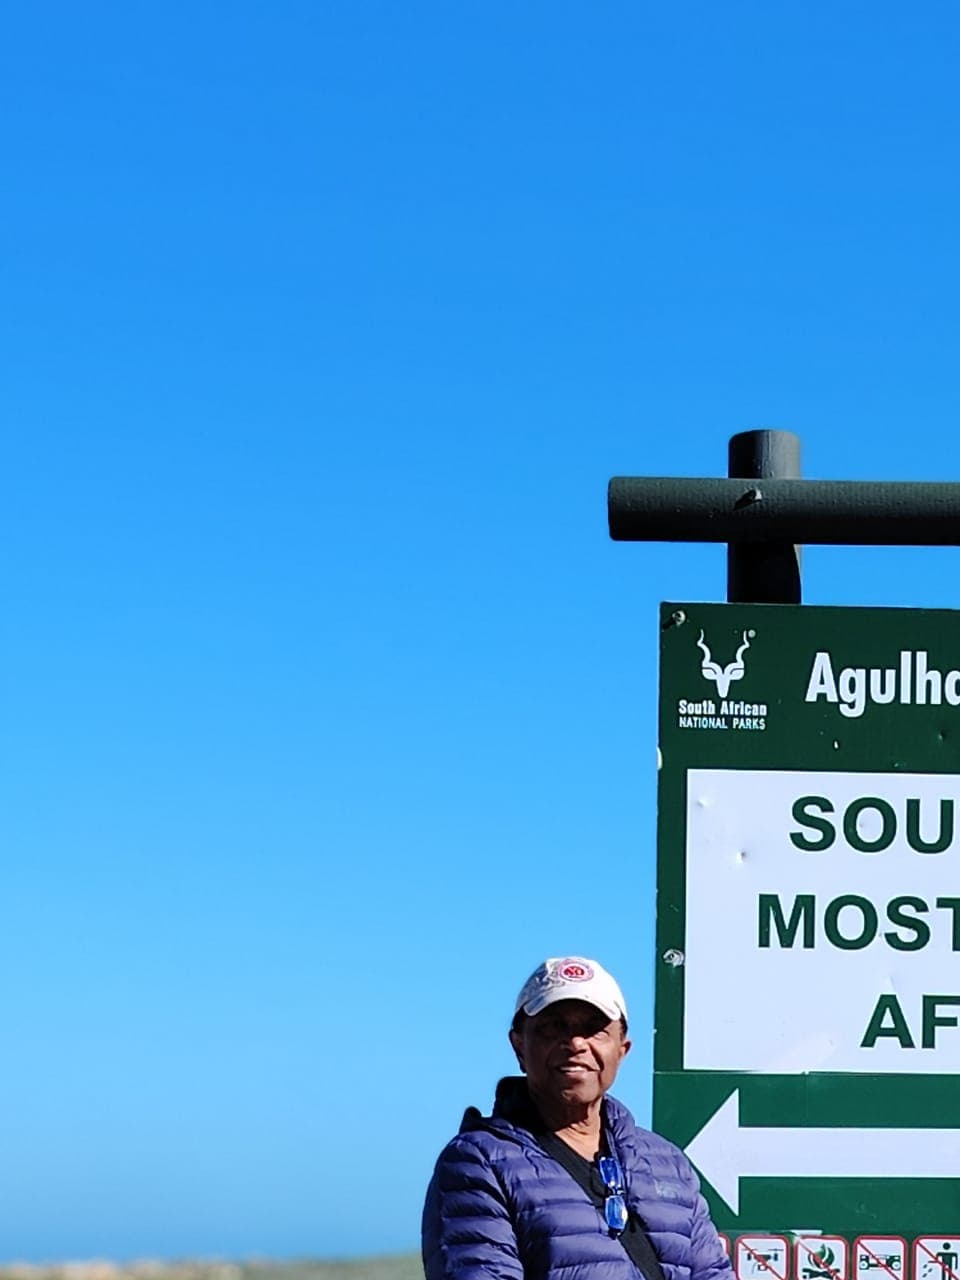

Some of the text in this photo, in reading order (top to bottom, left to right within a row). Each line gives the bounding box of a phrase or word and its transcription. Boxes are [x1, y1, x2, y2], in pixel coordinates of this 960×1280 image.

[678, 699, 768, 717] South African
[679, 716, 766, 730] NATIONAL PARKS
